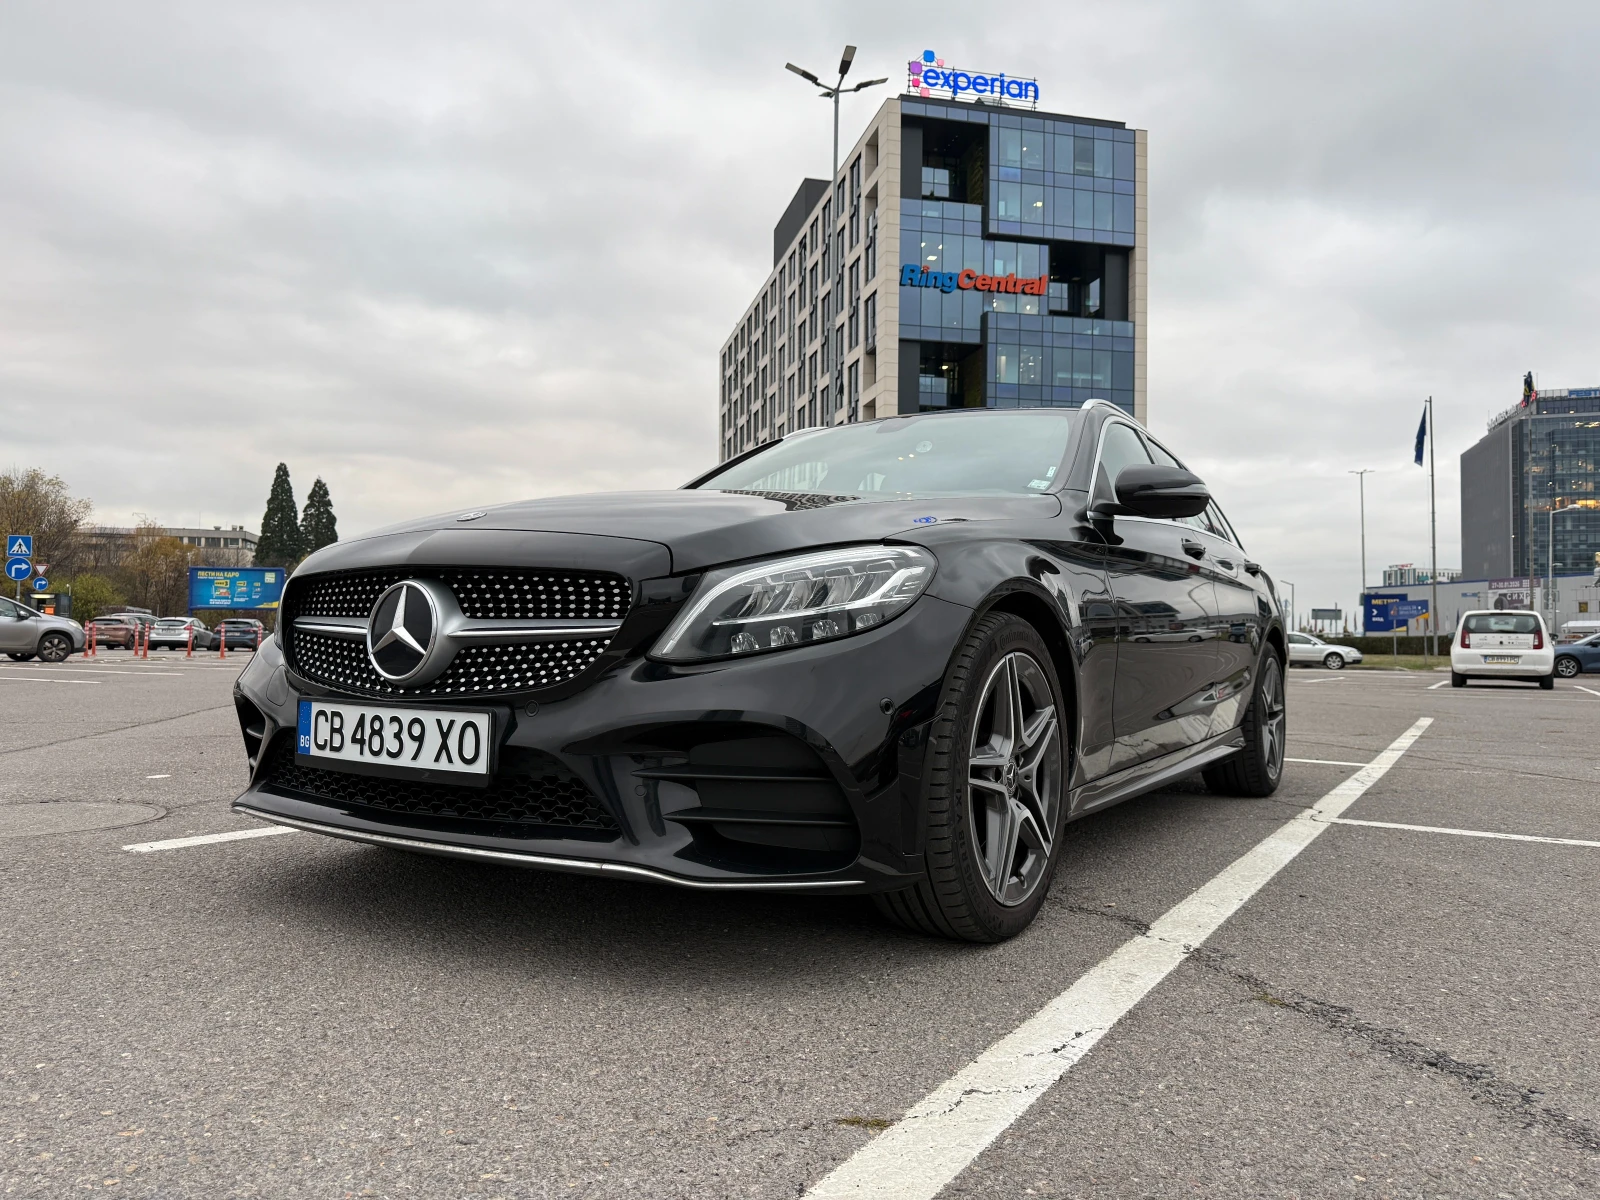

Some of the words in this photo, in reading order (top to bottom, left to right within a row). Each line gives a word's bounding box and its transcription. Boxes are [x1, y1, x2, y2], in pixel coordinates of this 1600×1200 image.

[922, 67, 1040, 101] experian
[900, 264, 1048, 296] RingCentral
[299, 734, 310, 748] BG
[350, 712, 426, 761] 4839
